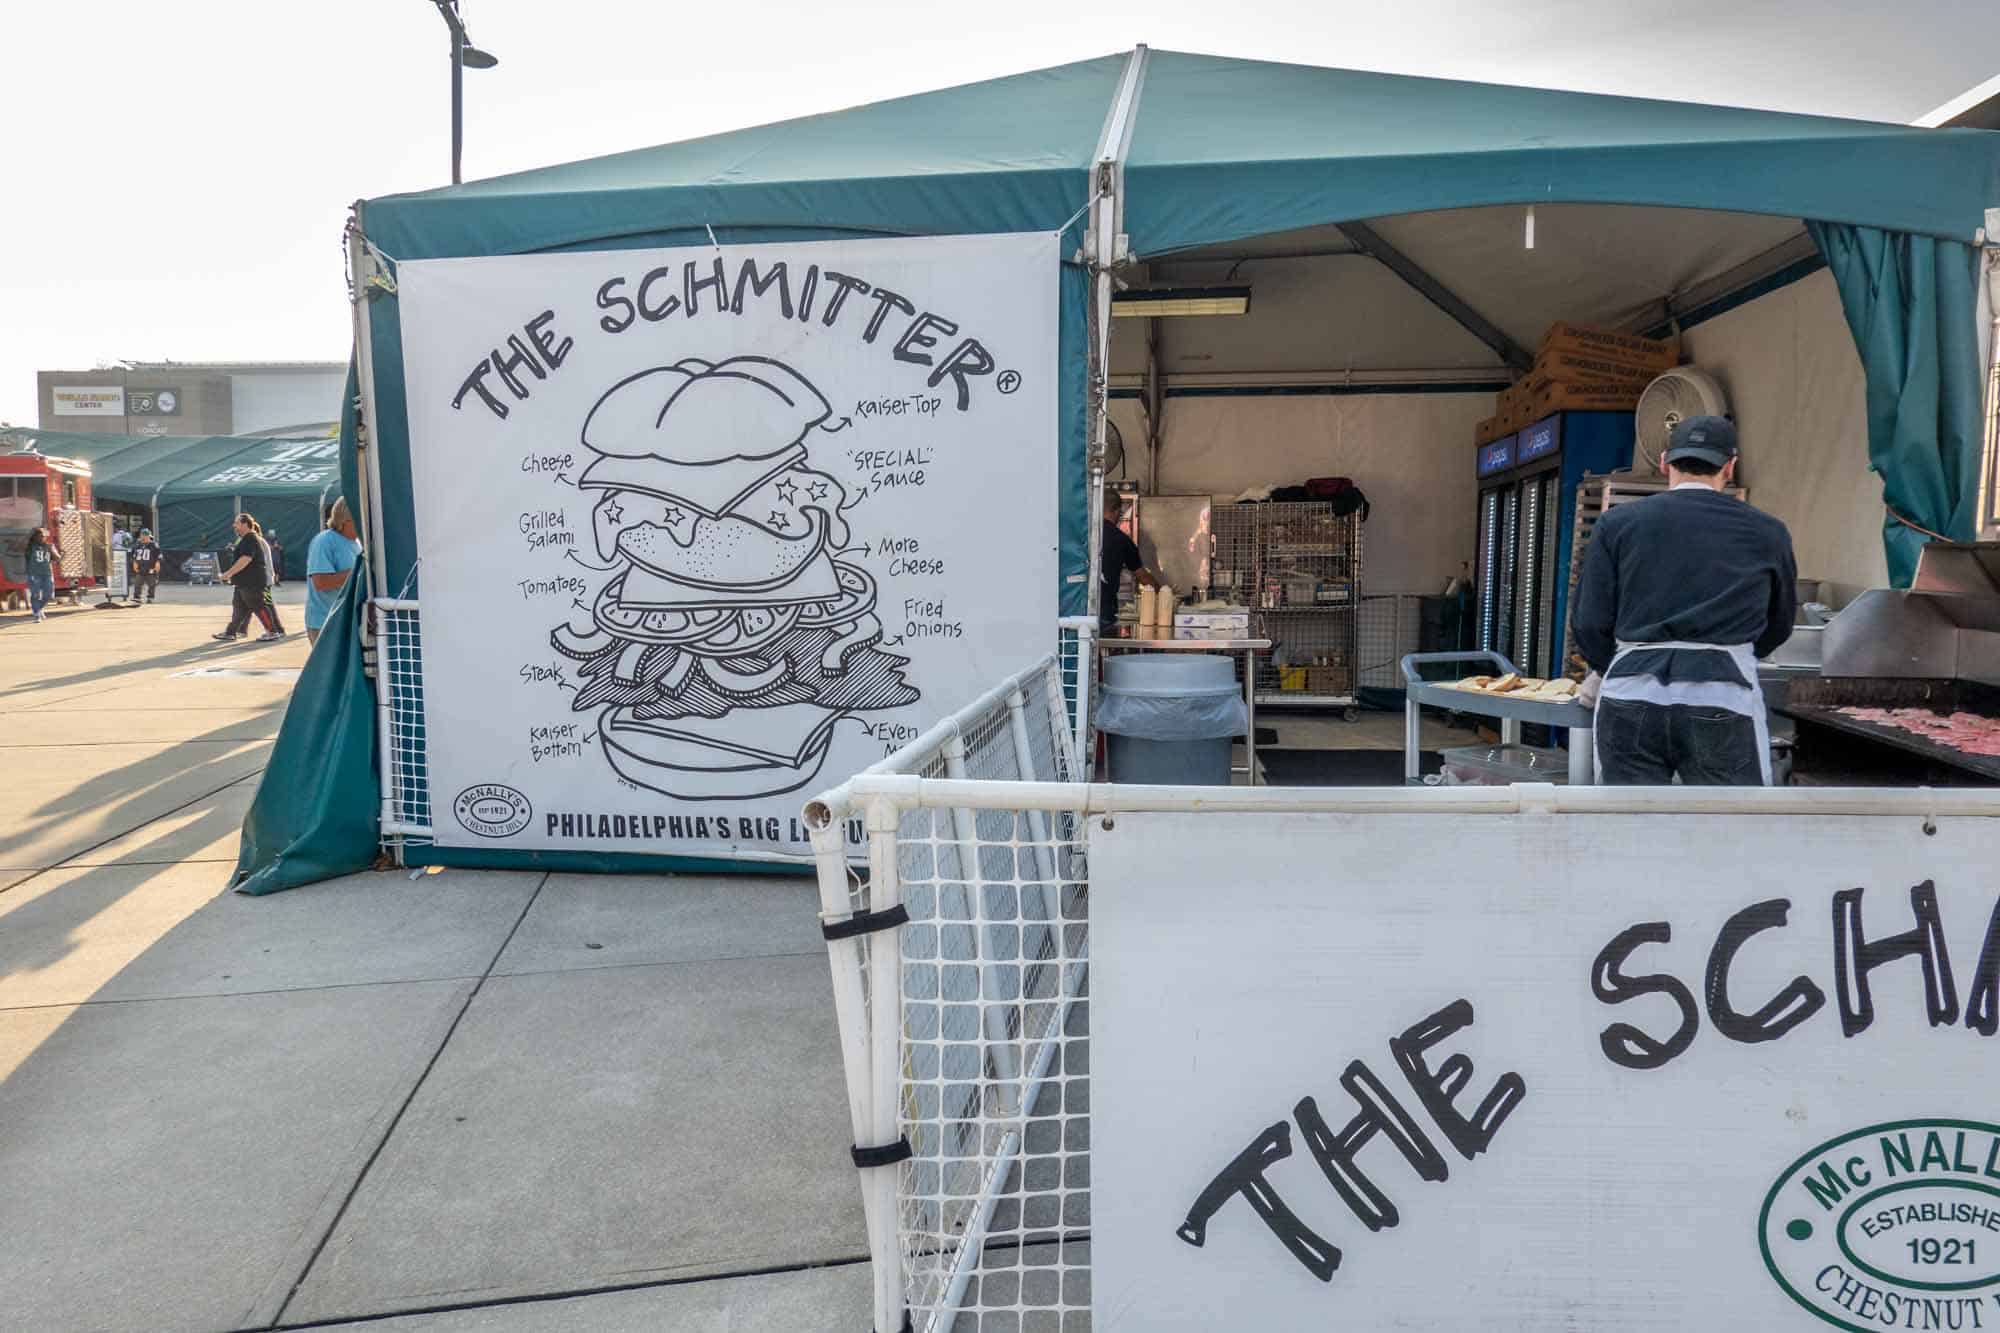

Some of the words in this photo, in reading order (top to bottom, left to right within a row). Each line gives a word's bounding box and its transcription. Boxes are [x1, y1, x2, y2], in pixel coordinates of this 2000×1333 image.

[451, 310, 574, 420] THE
[597, 257, 995, 412] SCHMITTER
[909, 394, 942, 417] Top
[203, 472, 328, 482] HOUSE
[519, 507, 565, 534] Grilled
[879, 537, 919, 556] More
[889, 557, 944, 576] Cheese
[518, 575, 586, 600] Tomatoes
[905, 597, 943, 620] Fried
[906, 621, 962, 638] Onions
[520, 662, 563, 684] Steak
[530, 723, 578, 743] Kaiser
[879, 722, 919, 741] Even
[531, 742, 582, 762] Bottom
[546, 813, 731, 839] PHILADELPHIA'S
[739, 817, 780, 842] BIG
[1176, 998, 1527, 1283] THE
[1906, 1238, 1976, 1265] 1921
[1815, 1265, 1984, 1331] CHESTNUT
